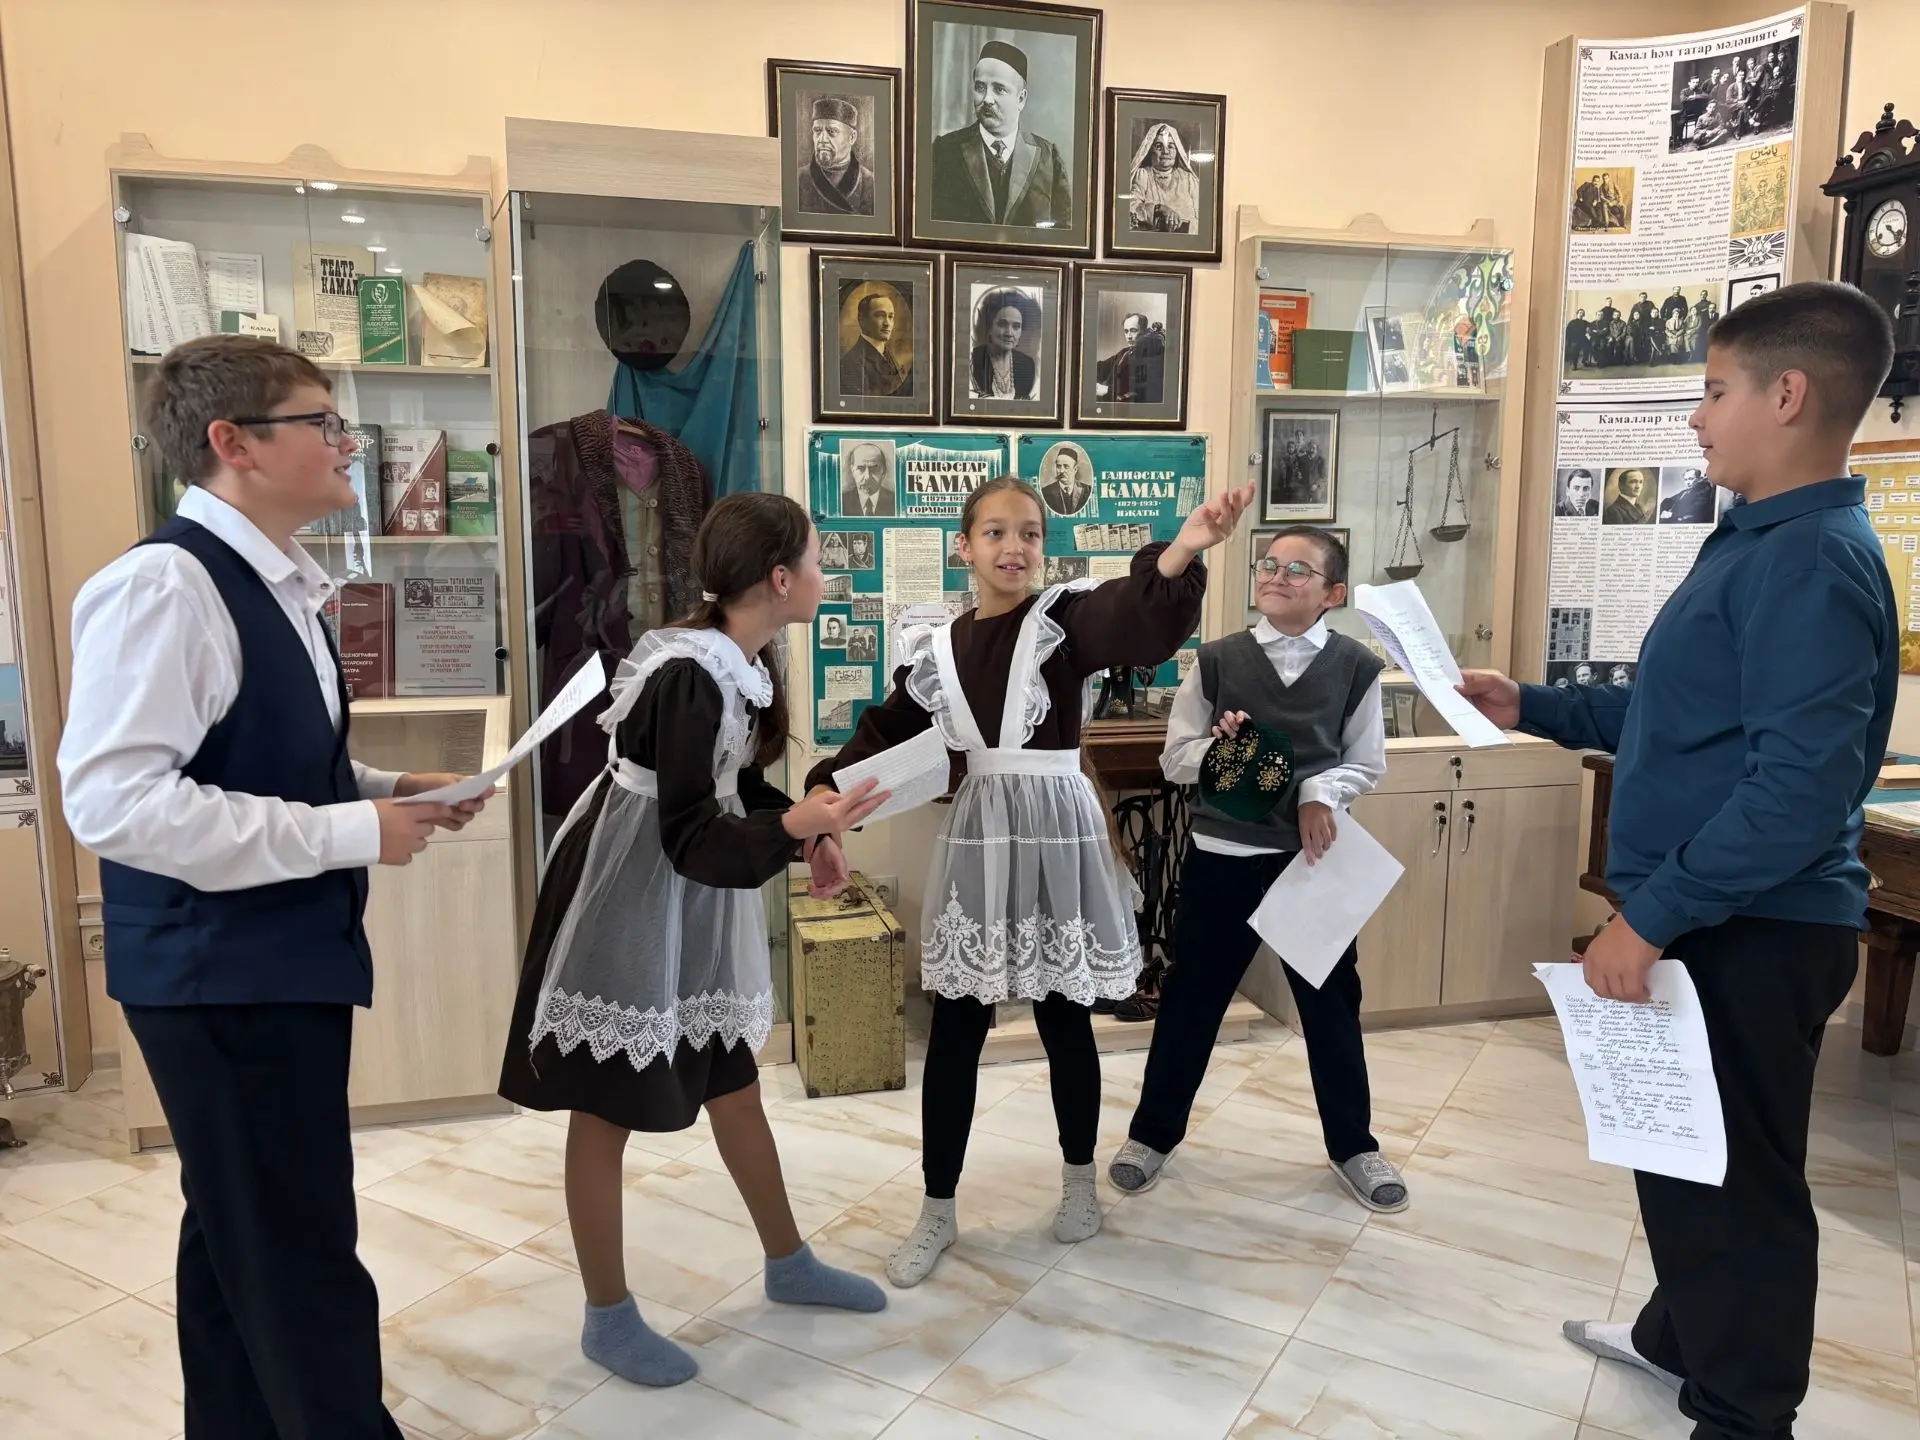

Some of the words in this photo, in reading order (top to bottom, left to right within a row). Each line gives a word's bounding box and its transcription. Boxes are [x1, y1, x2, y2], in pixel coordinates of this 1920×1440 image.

[1609, 50, 1647, 61] Камал
[1651, 48, 1673, 59] һәм
[1678, 44, 1712, 57] татар
[1715, 28, 1778, 51] мәдәнияте
[320, 258, 354, 278] ТЕАТР
[1599, 415, 1662, 424] Камаллар
[908, 462, 986, 472] ГАЛИӘСГАР
[1102, 470, 1175, 480] ГАЛИӘСГАР
[1100, 482, 1176, 498] КАМАЛ
